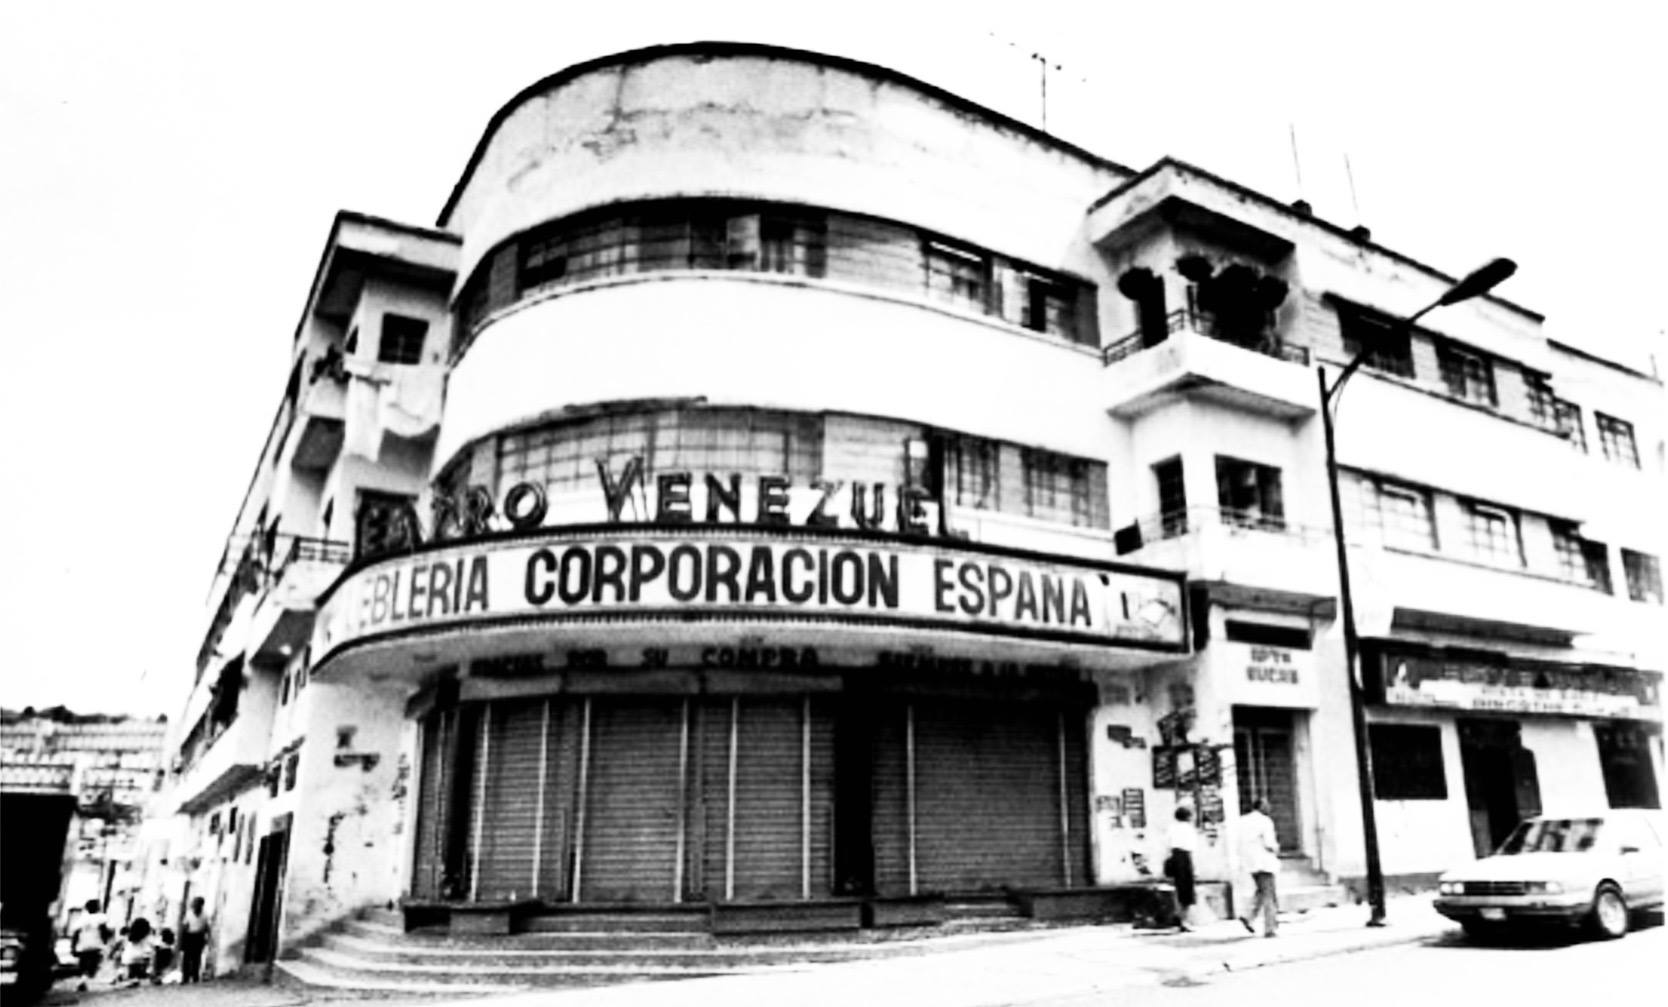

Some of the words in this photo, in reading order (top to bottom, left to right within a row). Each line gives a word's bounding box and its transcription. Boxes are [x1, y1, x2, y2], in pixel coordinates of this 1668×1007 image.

[526, 544, 898, 607] CORPORACION
[935, 559, 1091, 626] ESPANA
[702, 647, 819, 670] COMPRA
